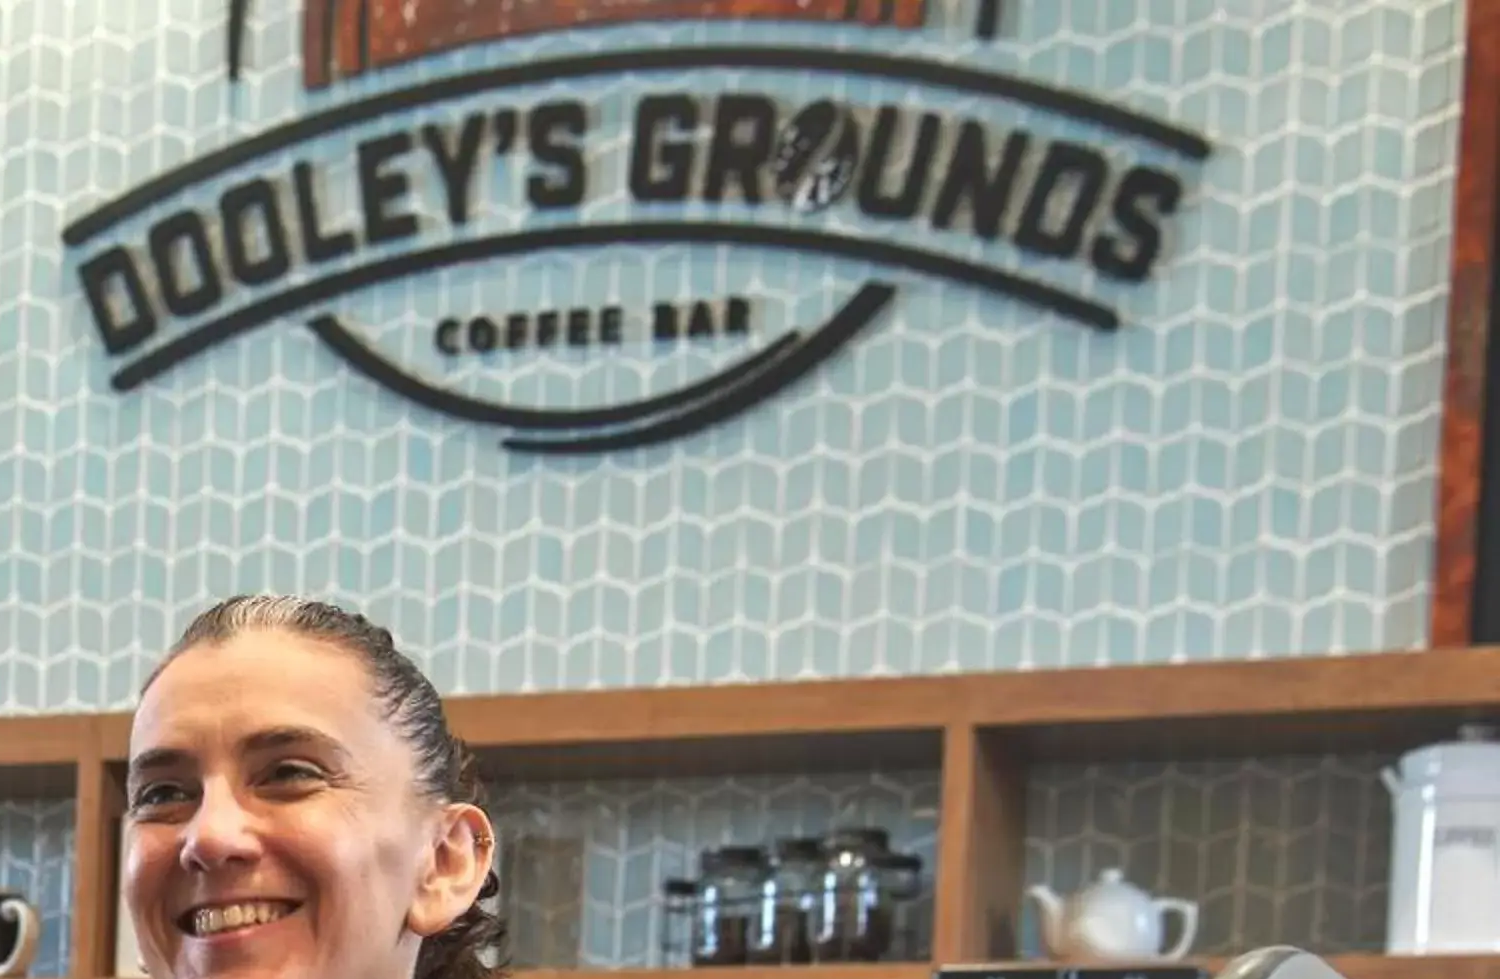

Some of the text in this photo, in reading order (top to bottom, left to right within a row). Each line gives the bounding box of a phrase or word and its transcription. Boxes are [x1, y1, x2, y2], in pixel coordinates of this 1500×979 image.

[78, 100, 588, 356] DOOLEY'S
[435, 296, 750, 356] COFFEE BAR
